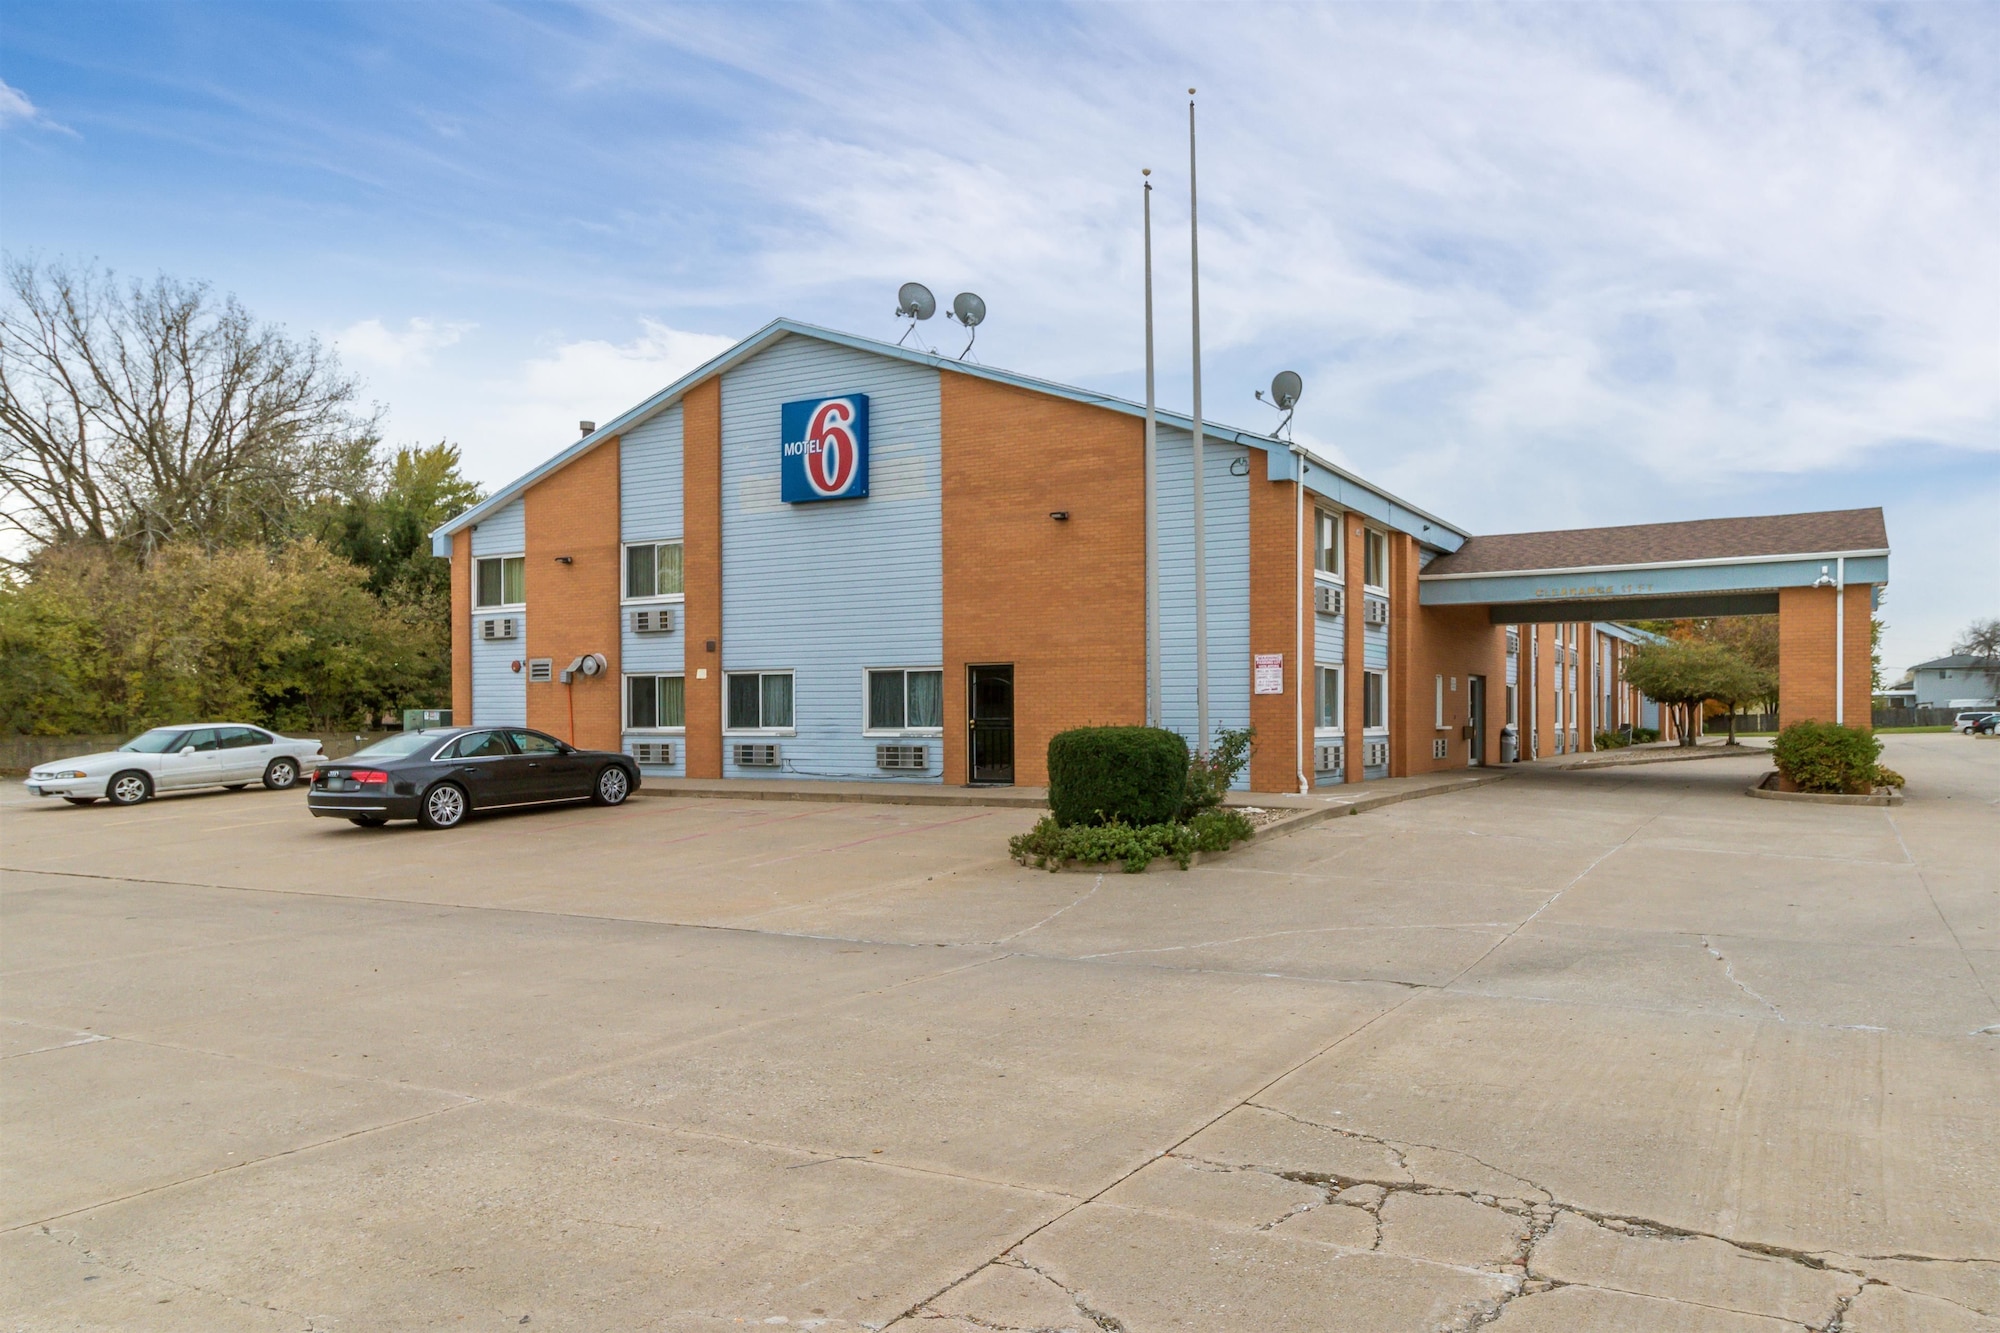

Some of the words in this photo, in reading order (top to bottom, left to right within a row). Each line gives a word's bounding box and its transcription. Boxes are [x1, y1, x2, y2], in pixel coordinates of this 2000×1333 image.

[784, 439, 823, 457] MOTEL
[805, 399, 857, 495] 6
[1535, 585, 1614, 597] CLEARANCE
